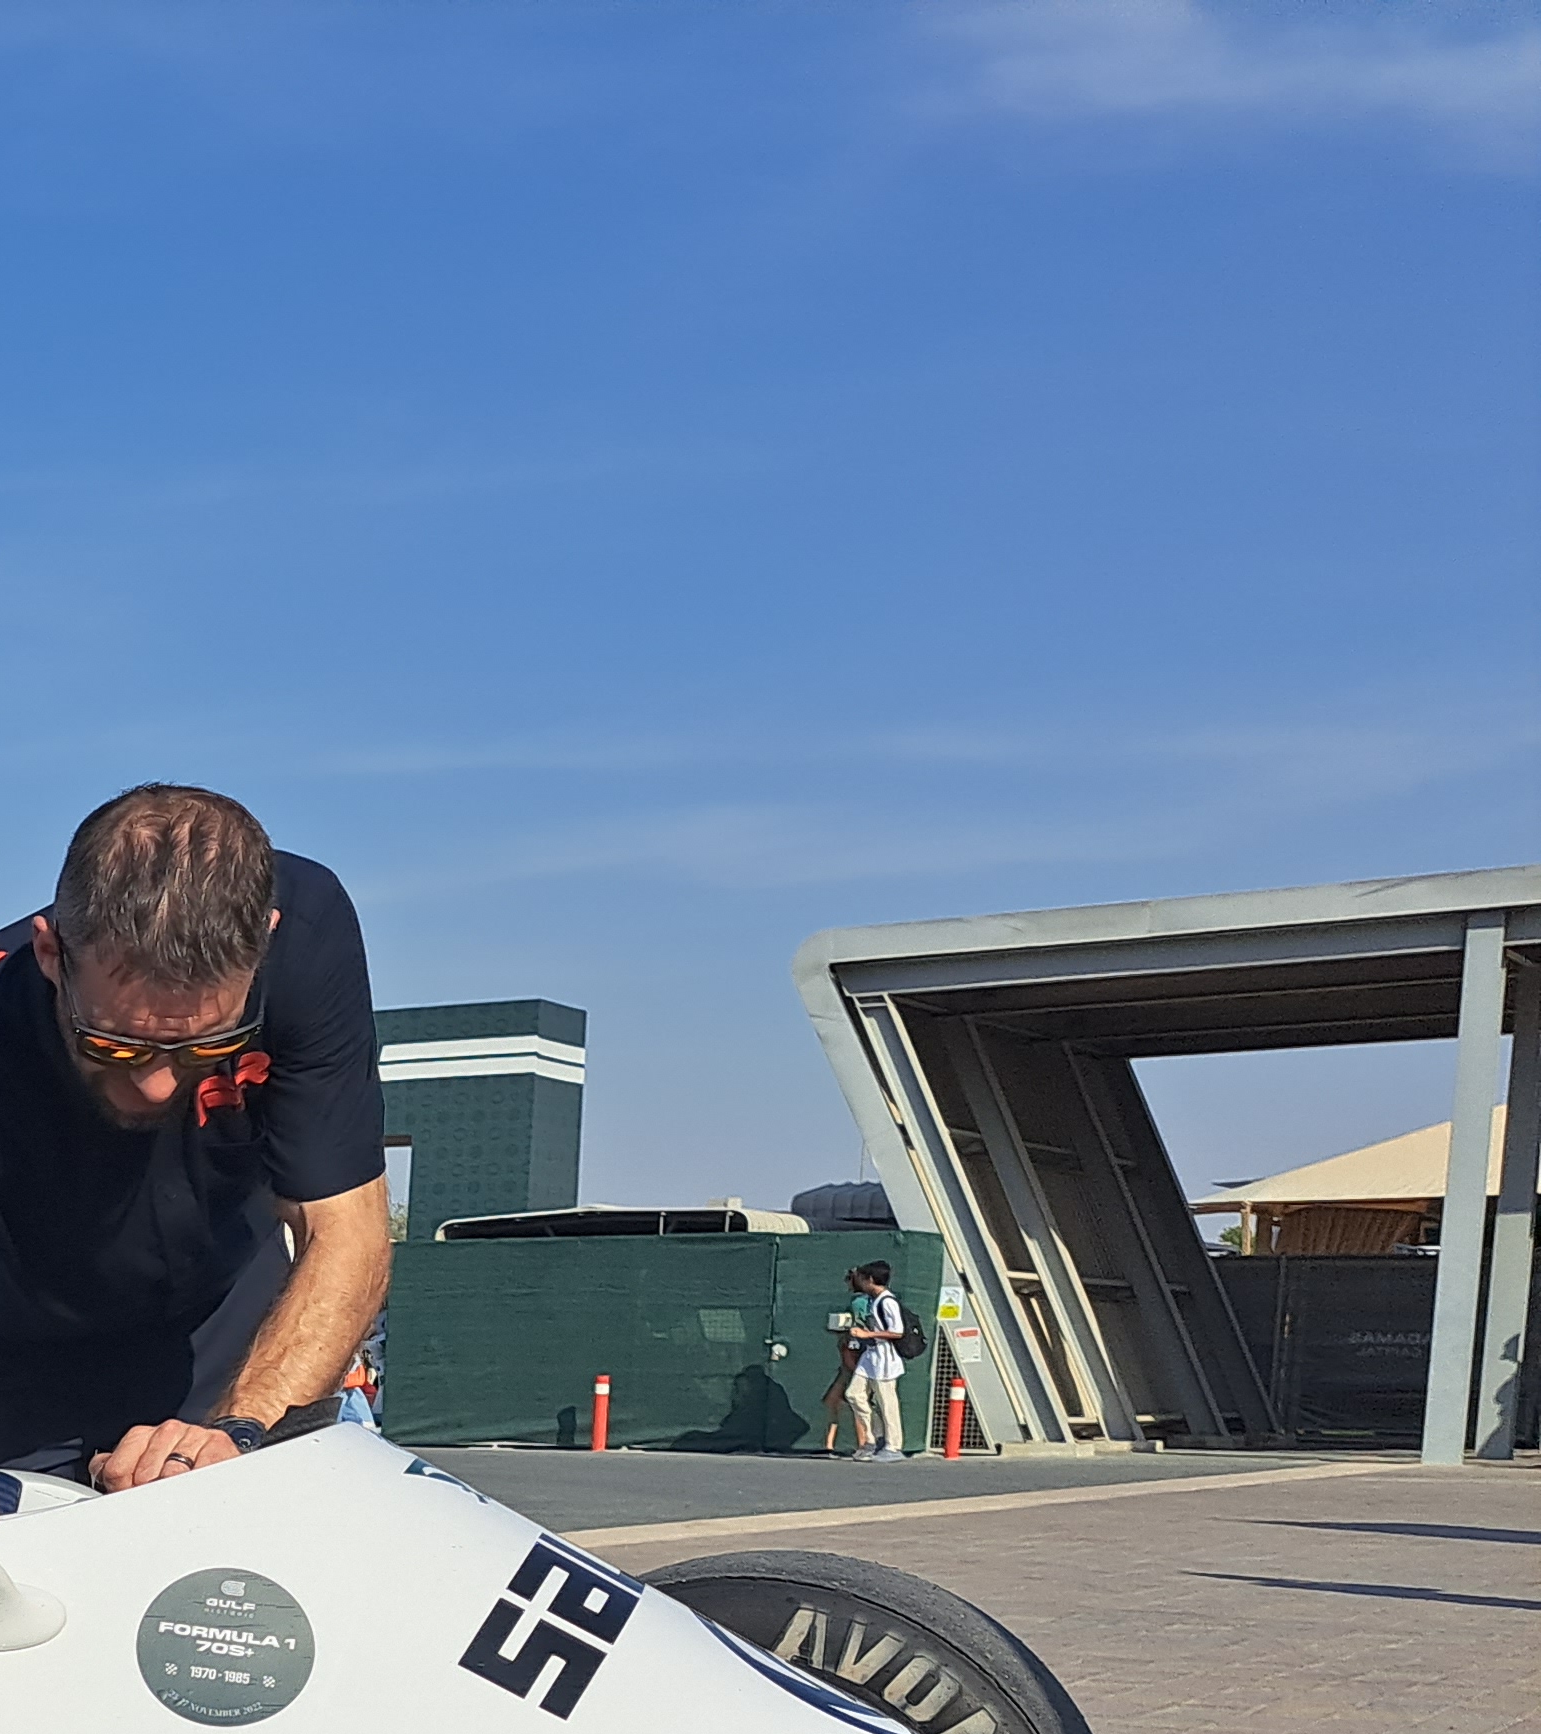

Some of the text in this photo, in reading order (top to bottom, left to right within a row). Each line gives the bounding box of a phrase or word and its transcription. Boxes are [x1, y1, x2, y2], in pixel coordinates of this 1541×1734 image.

[205, 1597, 257, 1611] GULF
[157, 1621, 297, 1651] FORMULA 1
